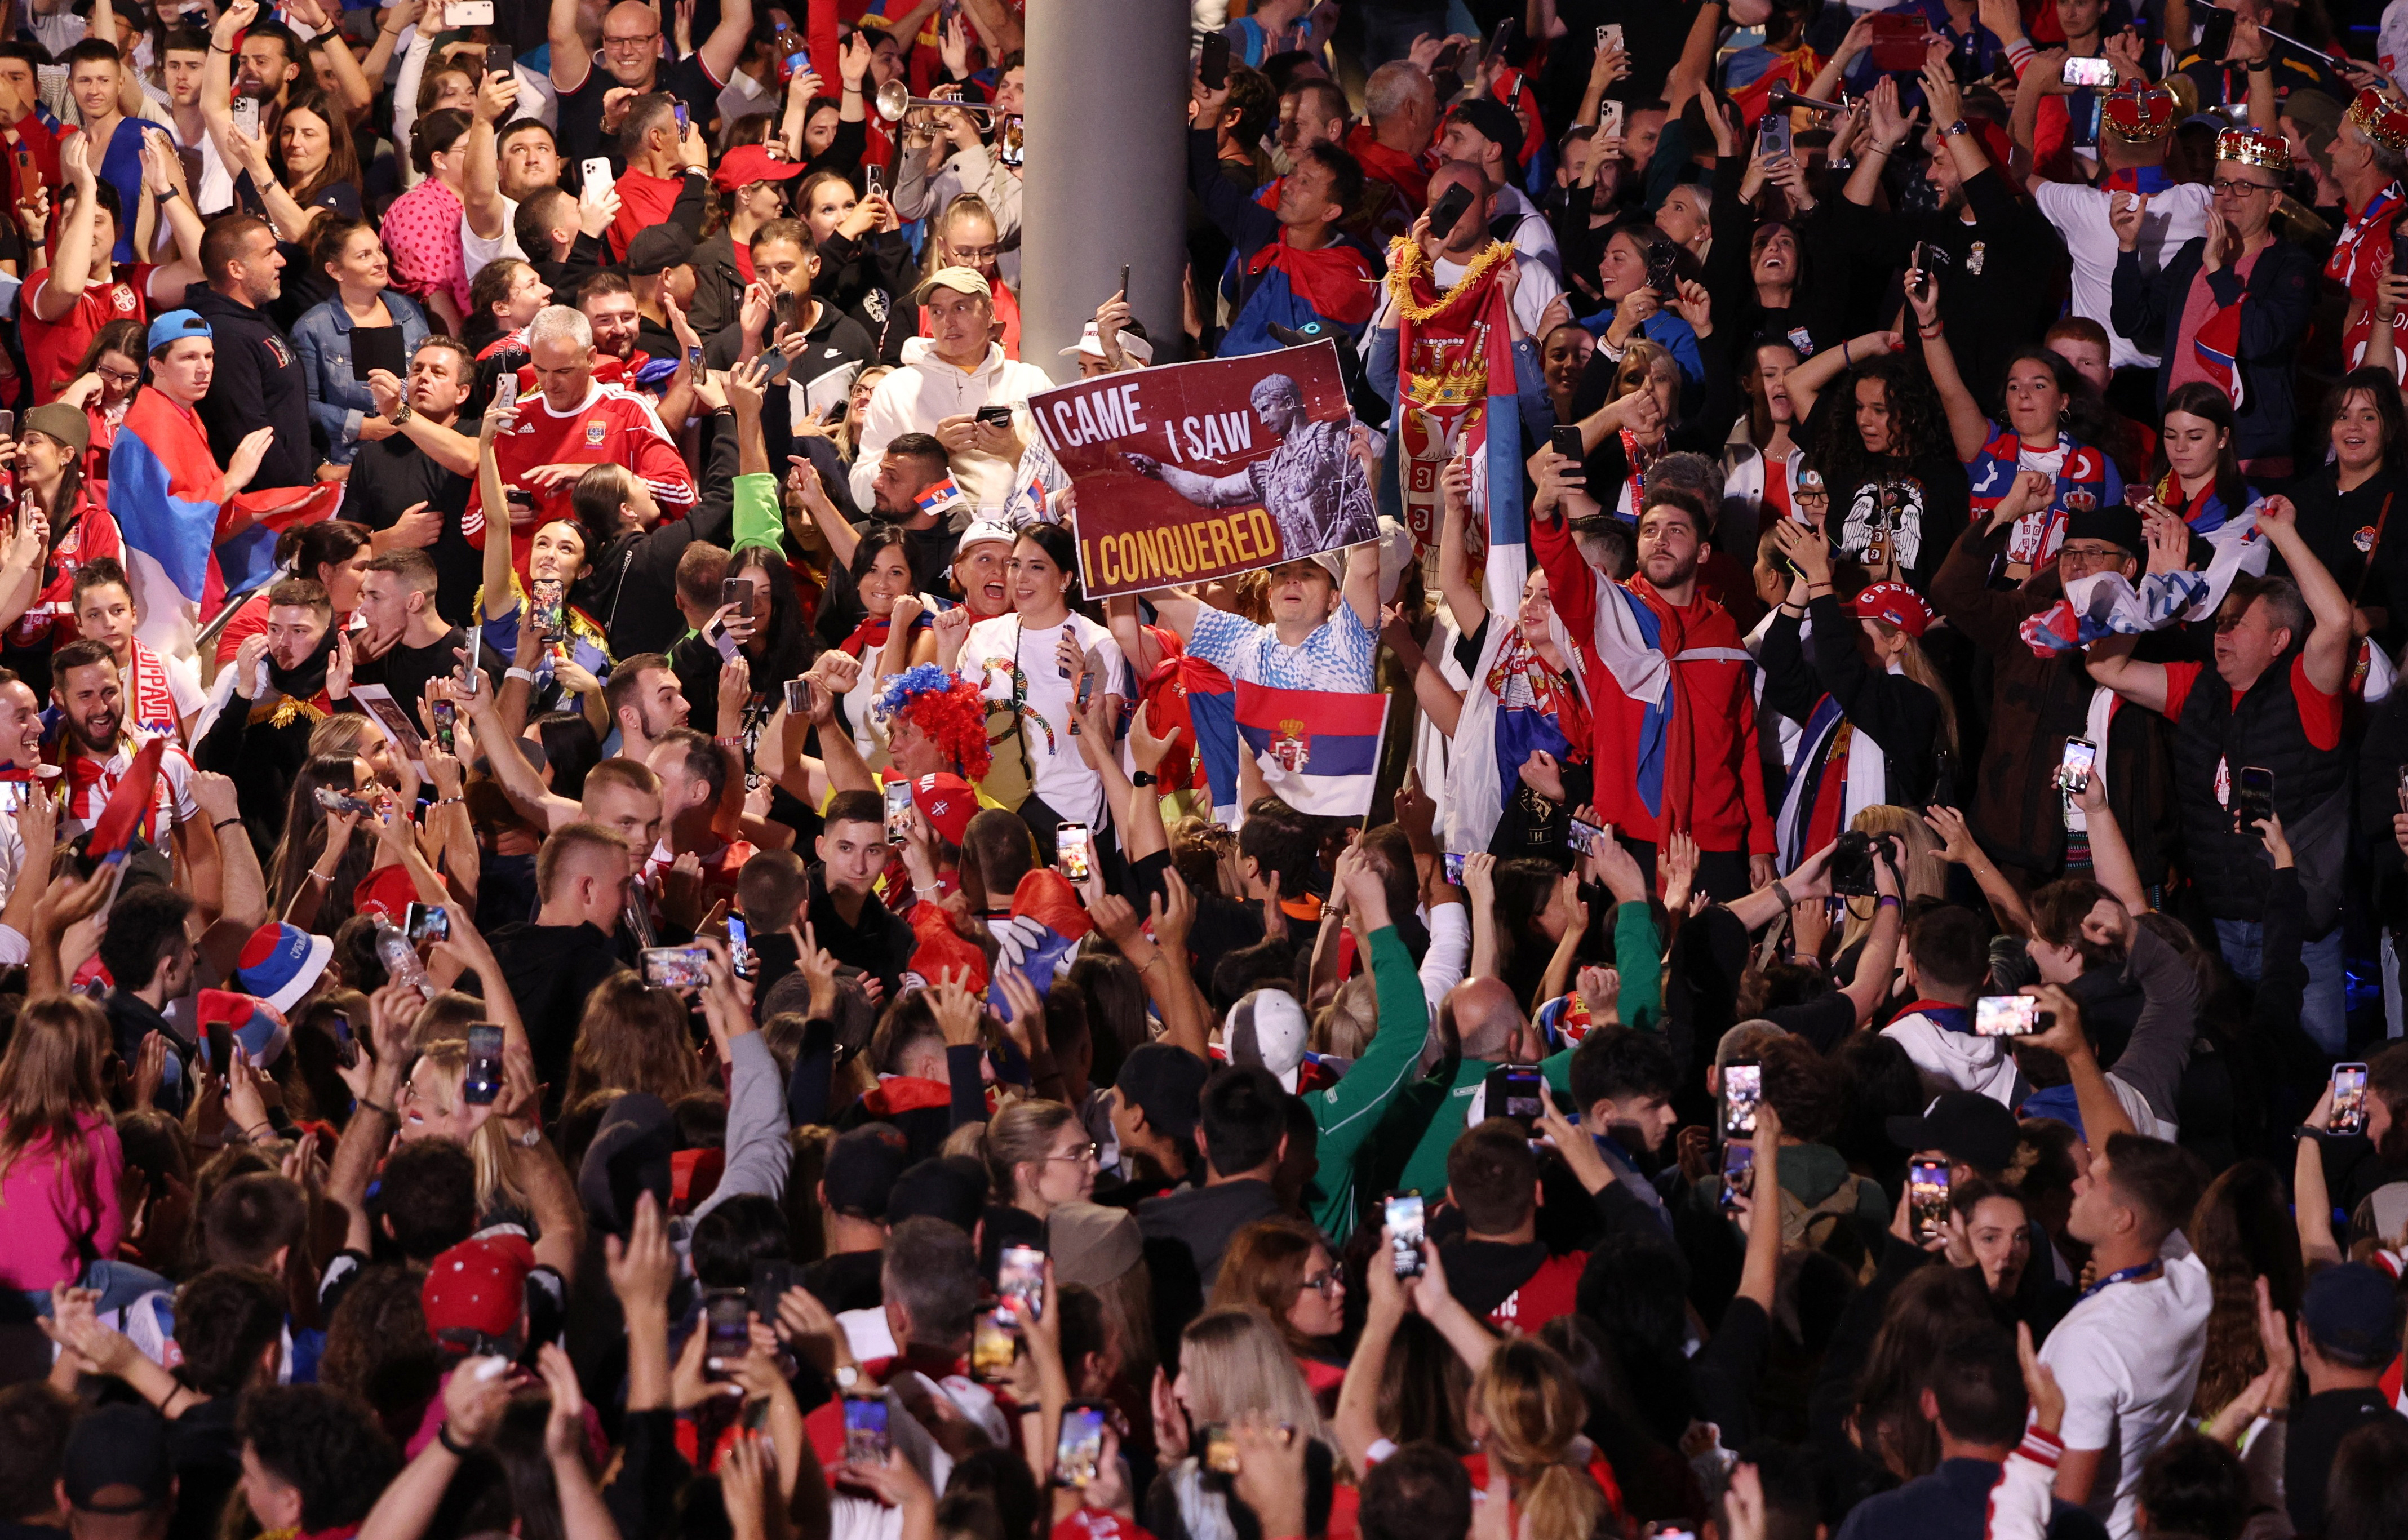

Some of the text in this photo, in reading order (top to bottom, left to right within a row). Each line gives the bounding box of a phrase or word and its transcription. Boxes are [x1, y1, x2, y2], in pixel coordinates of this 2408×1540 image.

[1035, 383, 1147, 451] I CAME
[1165, 410, 1252, 463] I SAW
[1798, 469, 1824, 486] NO
[1081, 508, 1276, 588] I CONQUERED
